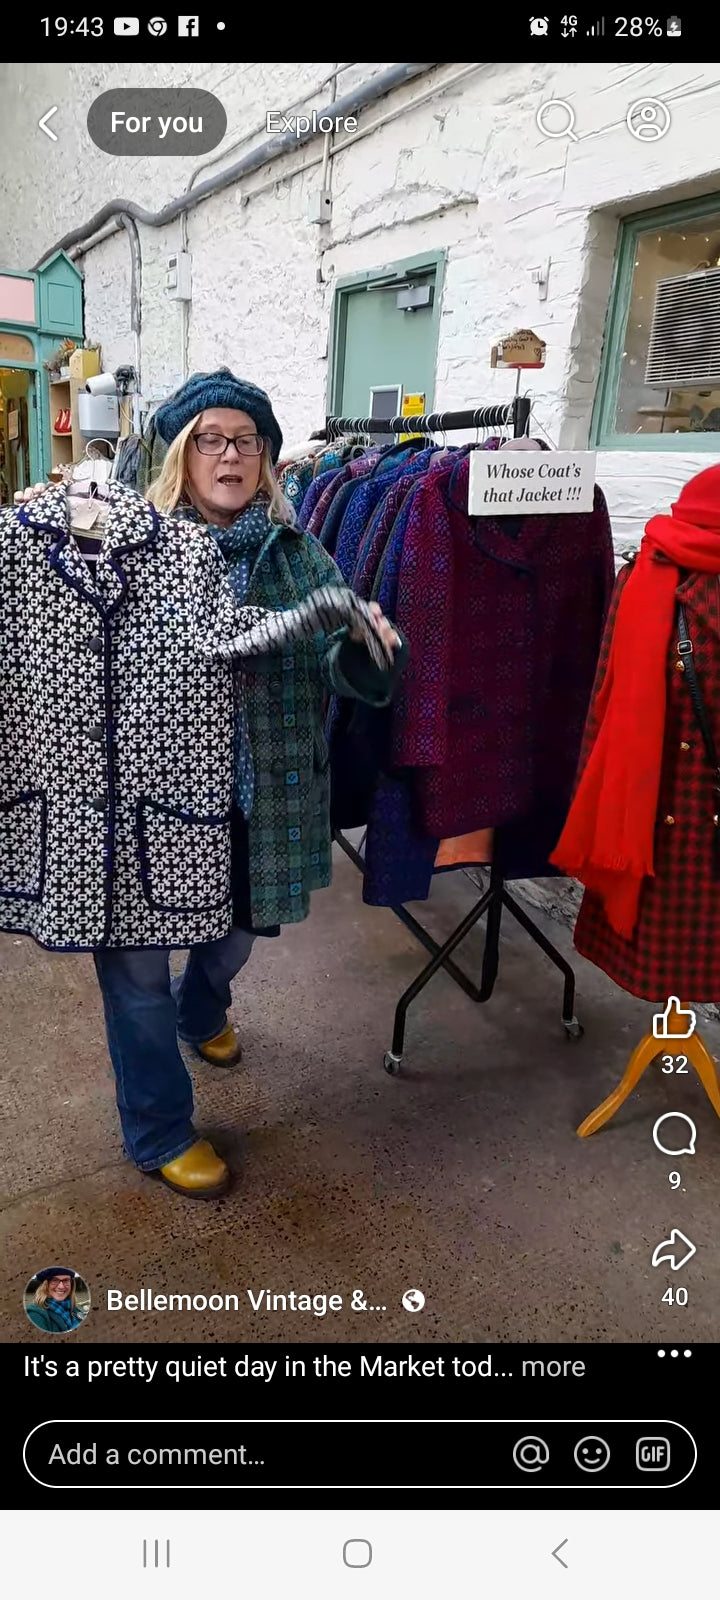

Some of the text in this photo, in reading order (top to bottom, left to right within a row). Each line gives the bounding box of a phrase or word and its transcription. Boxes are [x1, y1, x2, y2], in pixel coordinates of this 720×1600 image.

[486, 463, 535, 479] Whose
[483, 486, 582, 503] that Jacket !!!
